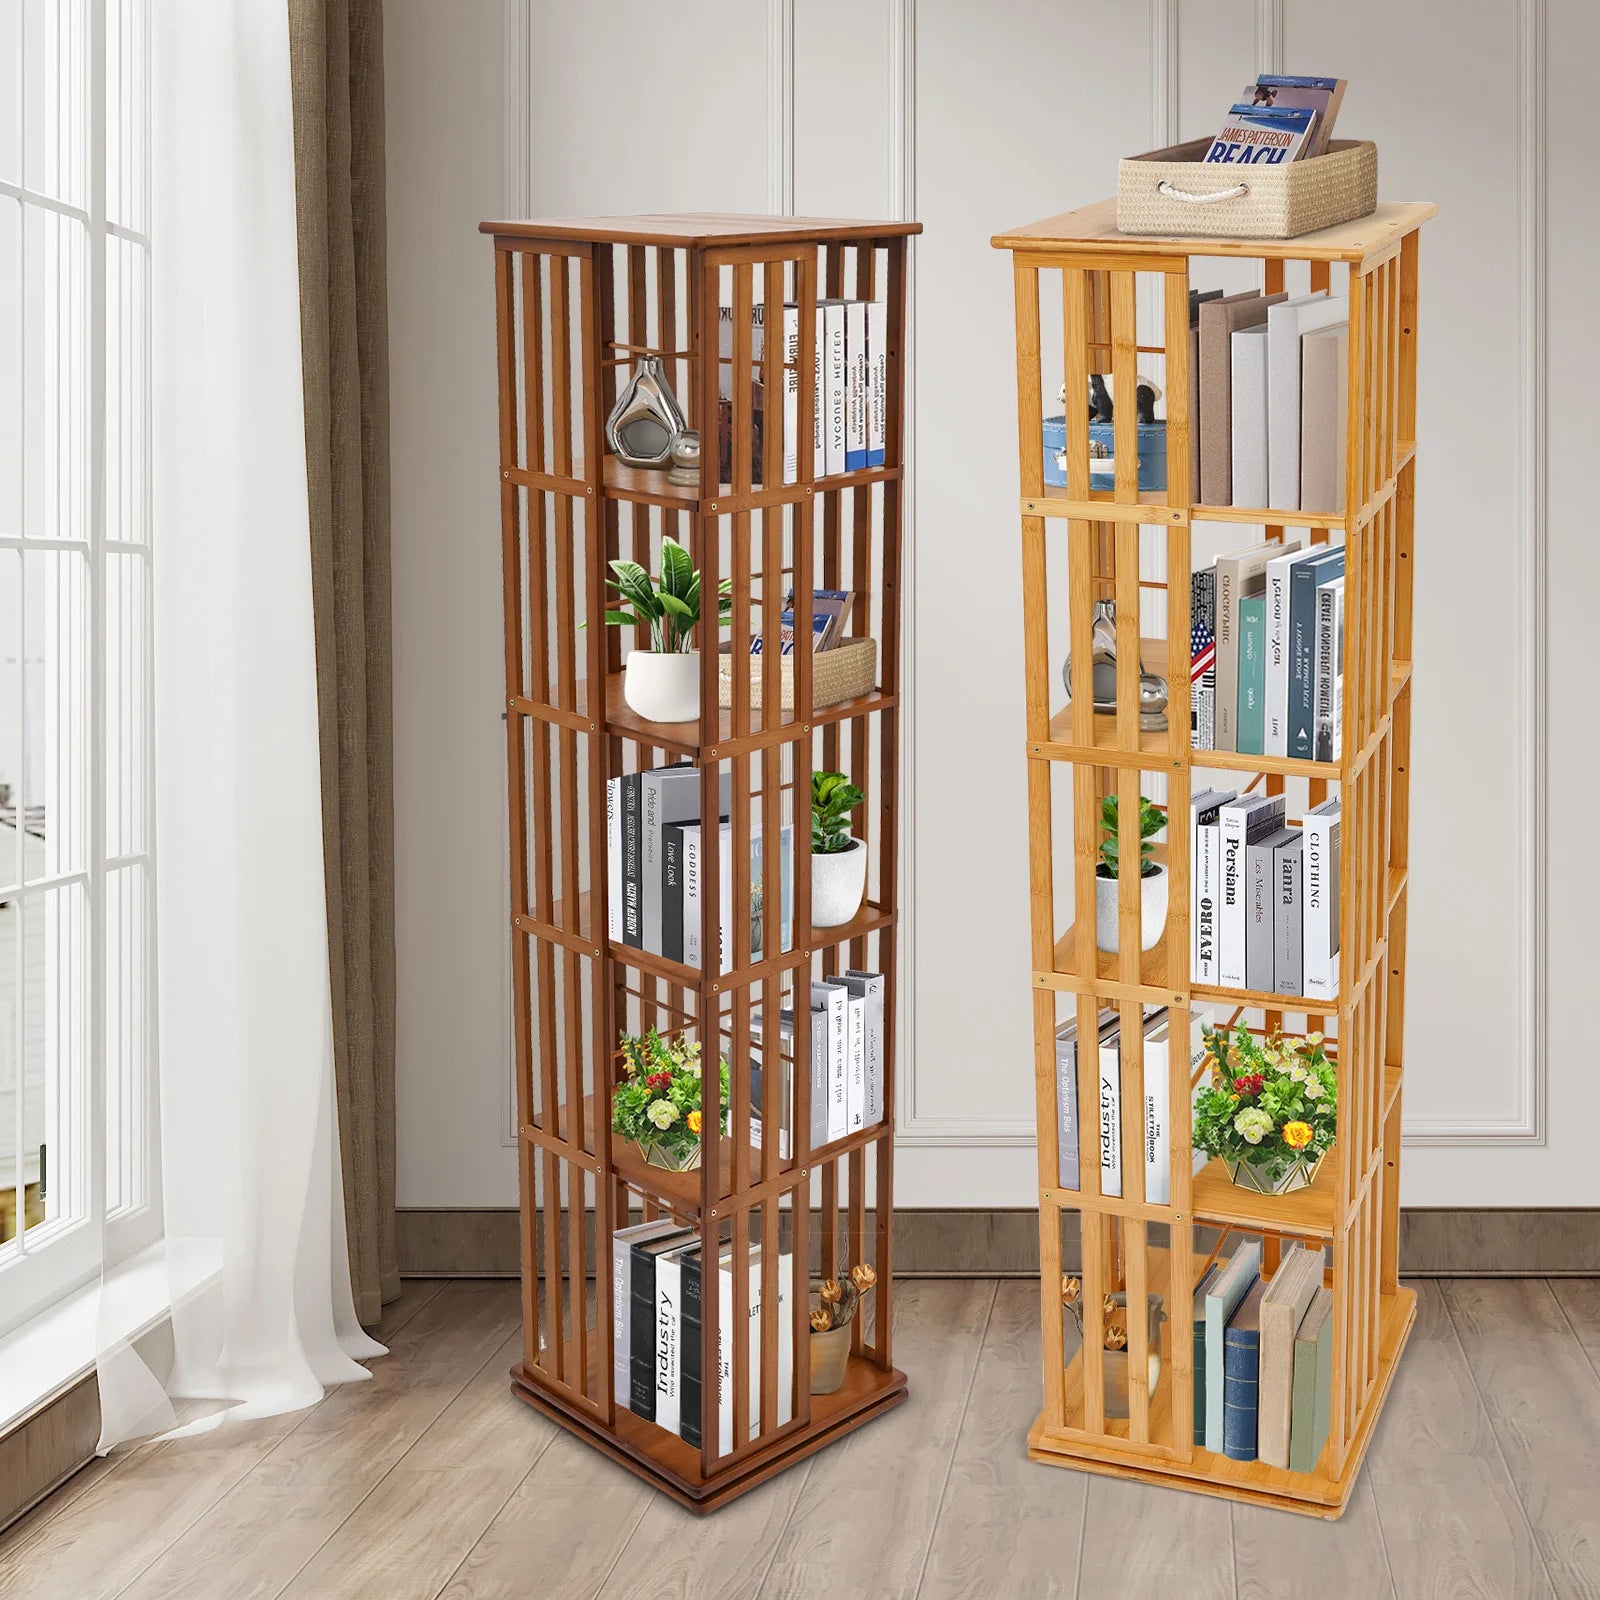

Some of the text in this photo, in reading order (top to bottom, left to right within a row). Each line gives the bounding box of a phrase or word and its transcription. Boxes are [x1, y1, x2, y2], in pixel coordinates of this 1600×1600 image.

[1217, 127, 1294, 147] JAMES PATTERSON
[647, 787, 656, 808] Pride
[648, 810, 656, 826] and
[668, 842, 676, 887] Love Look
[1226, 837, 1240, 905] Persiana
[1255, 859, 1263, 874] Les
[1282, 857, 1297, 905] ianra
[1310, 832, 1320, 909] CLOTHING
[1061, 1057, 1072, 1133] The Optimism Bias
[1100, 1077, 1113, 1169] Industry
[614, 1258, 623, 1274] The
[615, 1277, 624, 1319] Optimism
[657, 1291, 673, 1396] Industry
